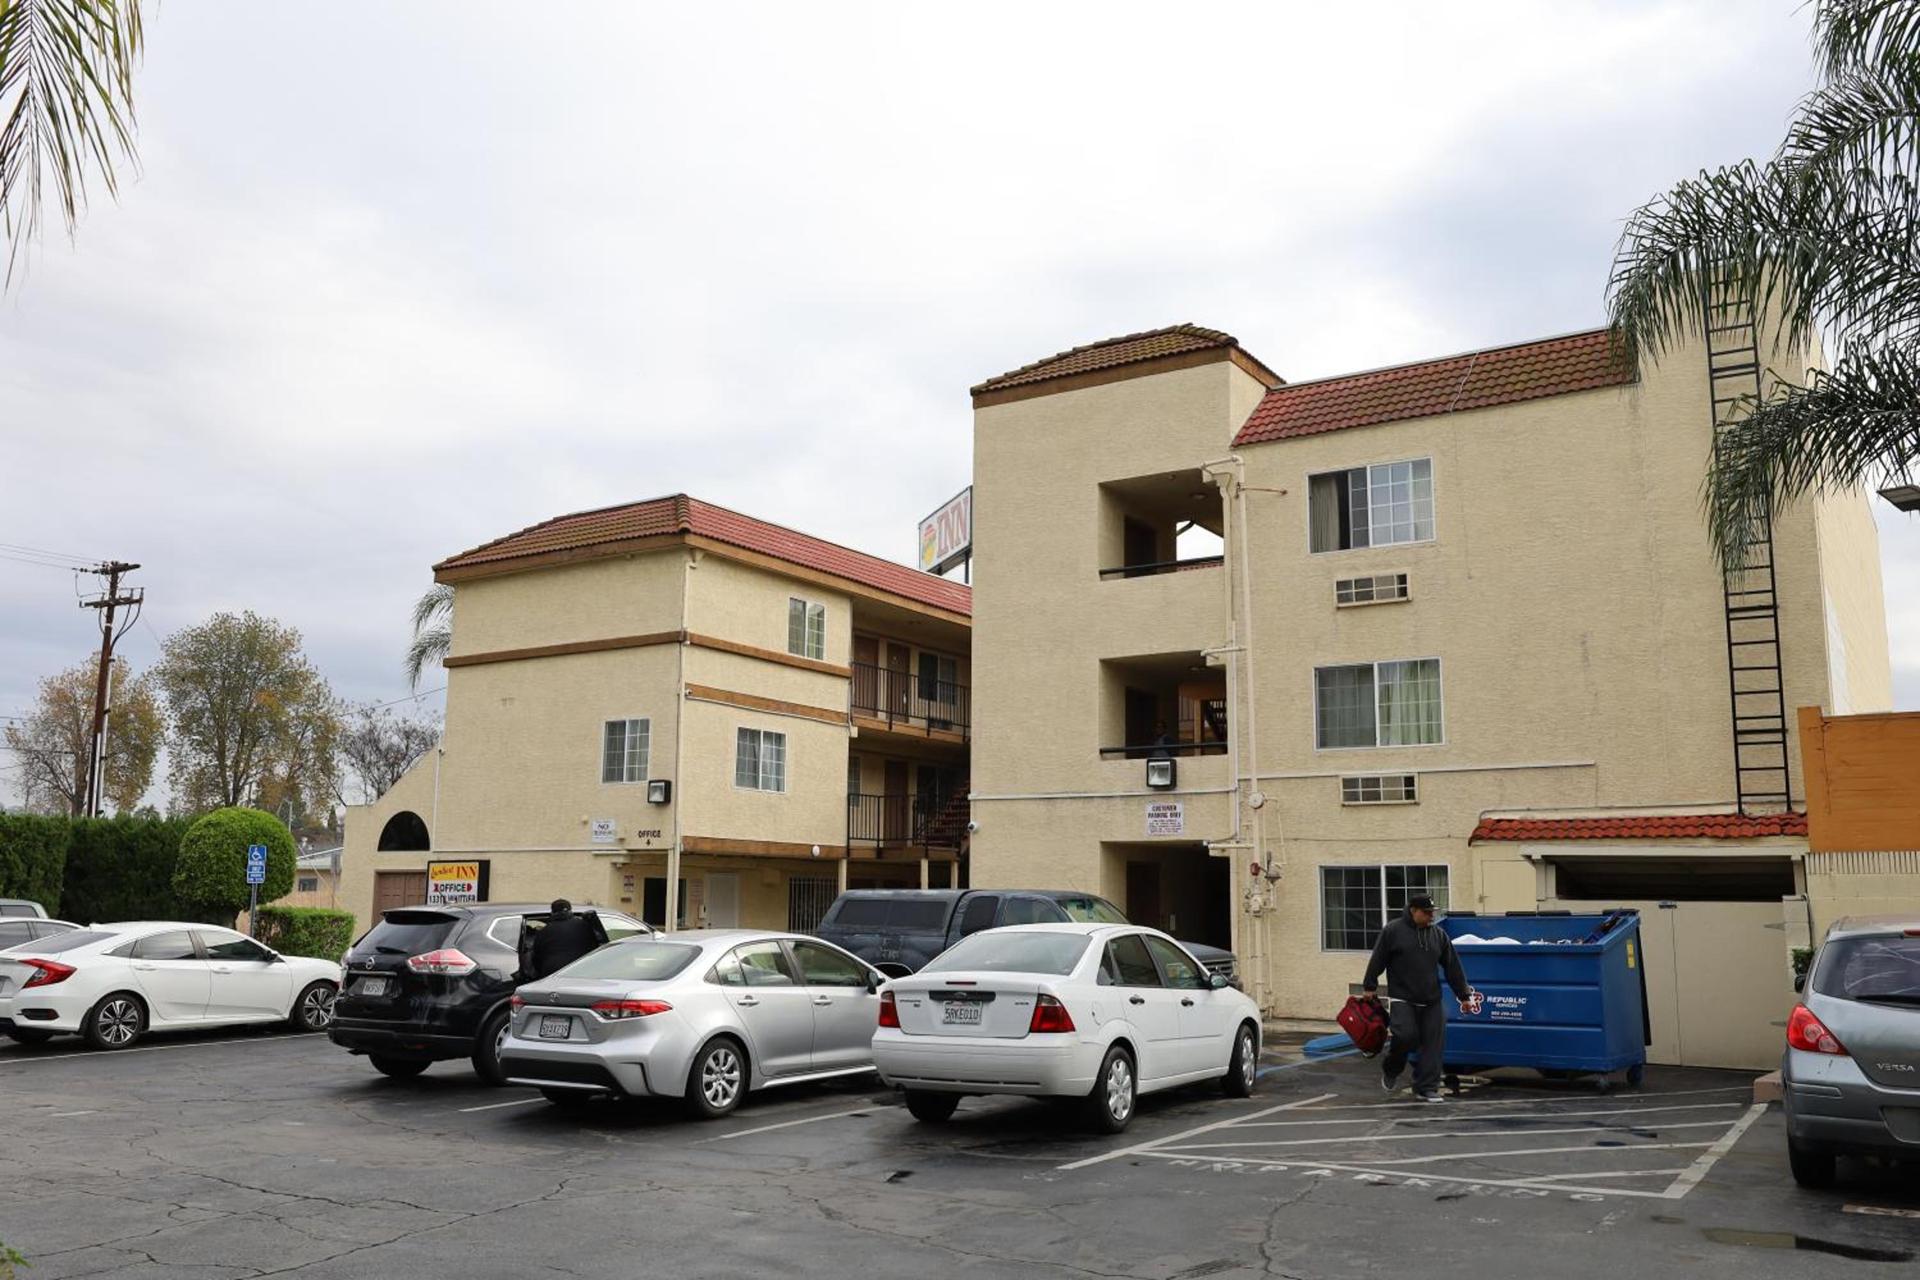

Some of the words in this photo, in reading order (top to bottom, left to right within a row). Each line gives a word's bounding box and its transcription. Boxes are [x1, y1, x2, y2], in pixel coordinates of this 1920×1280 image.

[937, 495, 970, 558] INN
[638, 830, 661, 838] OFFICE
[456, 865, 477, 878] INN
[440, 883, 466, 892] OFFICE
[1486, 996, 1527, 1004] REPUBLIC
[1876, 1063, 1916, 1072] VERSA
